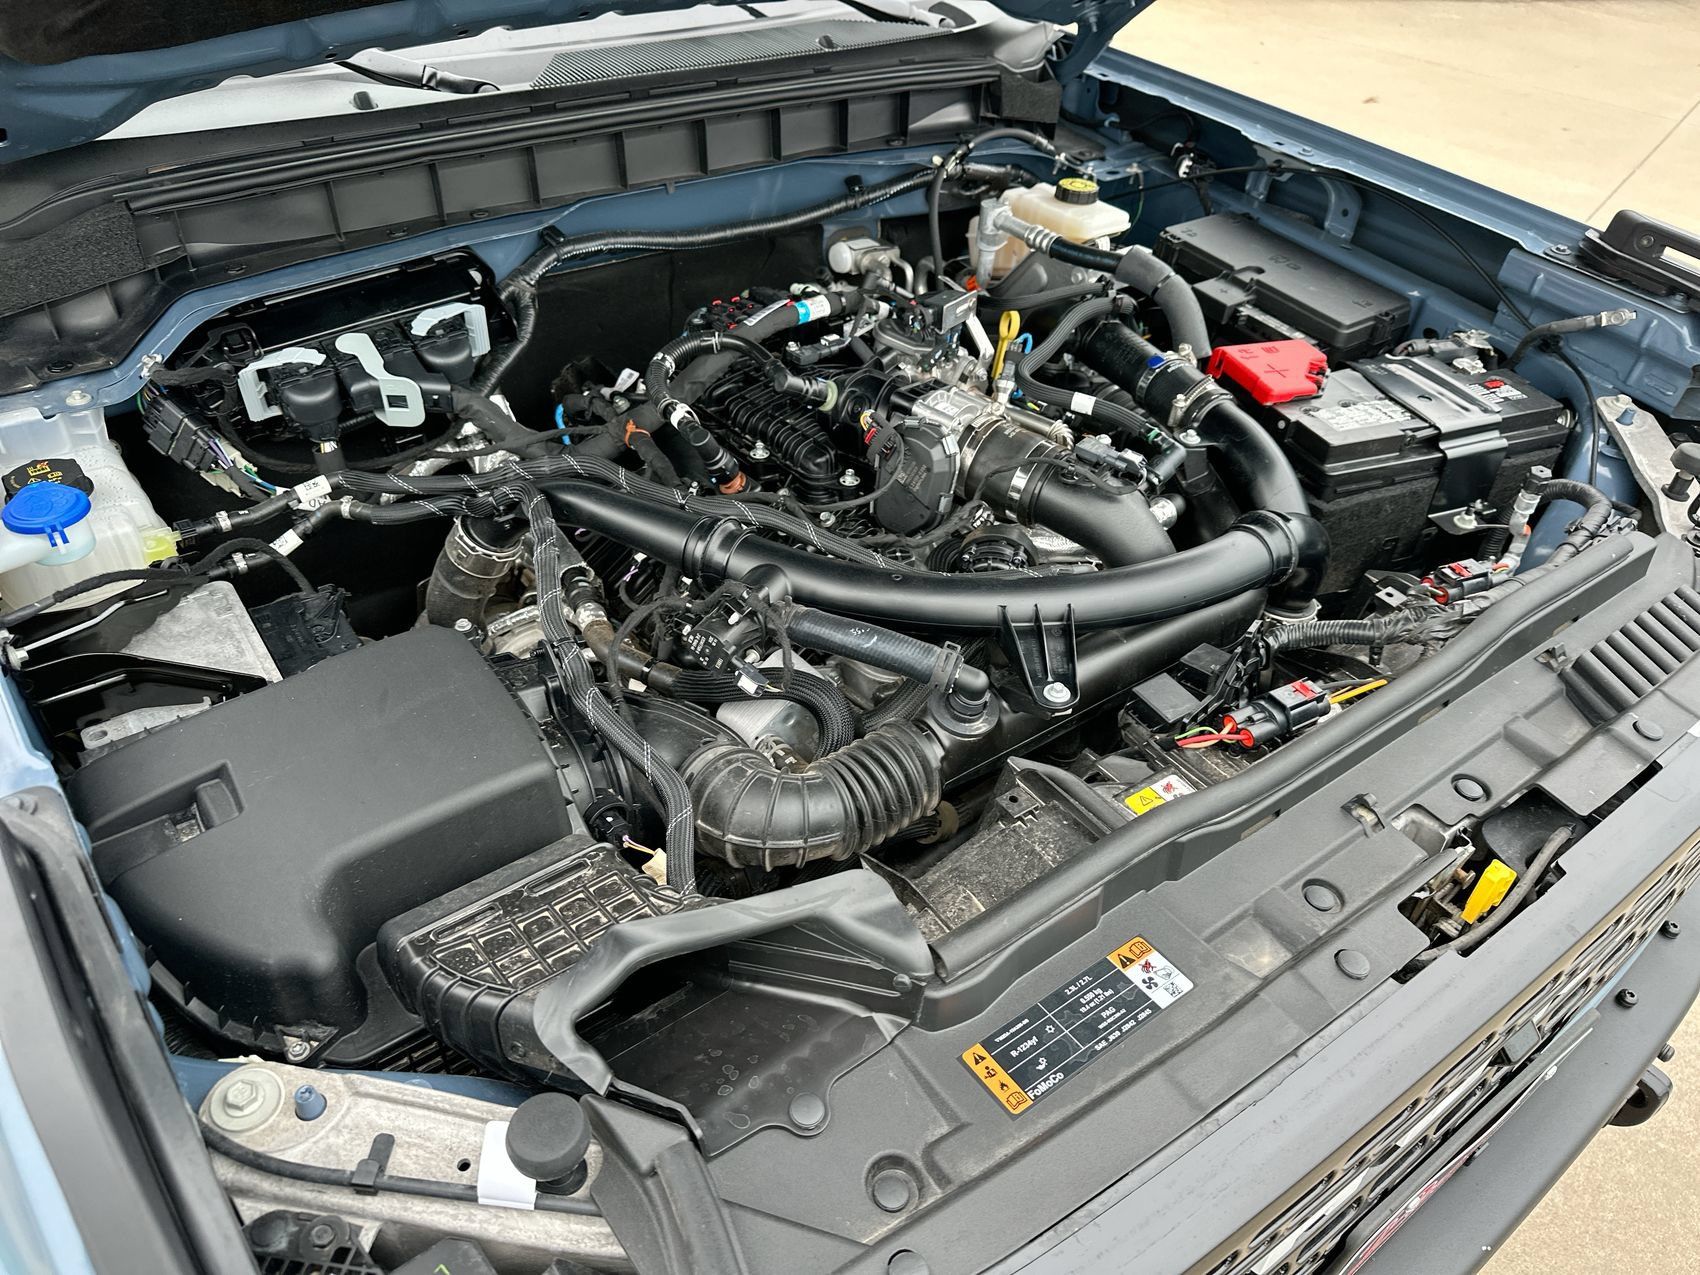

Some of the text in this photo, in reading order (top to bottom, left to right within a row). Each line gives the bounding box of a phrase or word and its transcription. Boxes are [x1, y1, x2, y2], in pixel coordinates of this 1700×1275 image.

[1078, 975, 1093, 986] 2.7L
[1100, 1006, 1117, 1019] PAG
[1009, 1035, 1039, 1058] R-1234yf
[1094, 1039, 1109, 1051] SAE
[1026, 1072, 1065, 1100] FoMoCo
